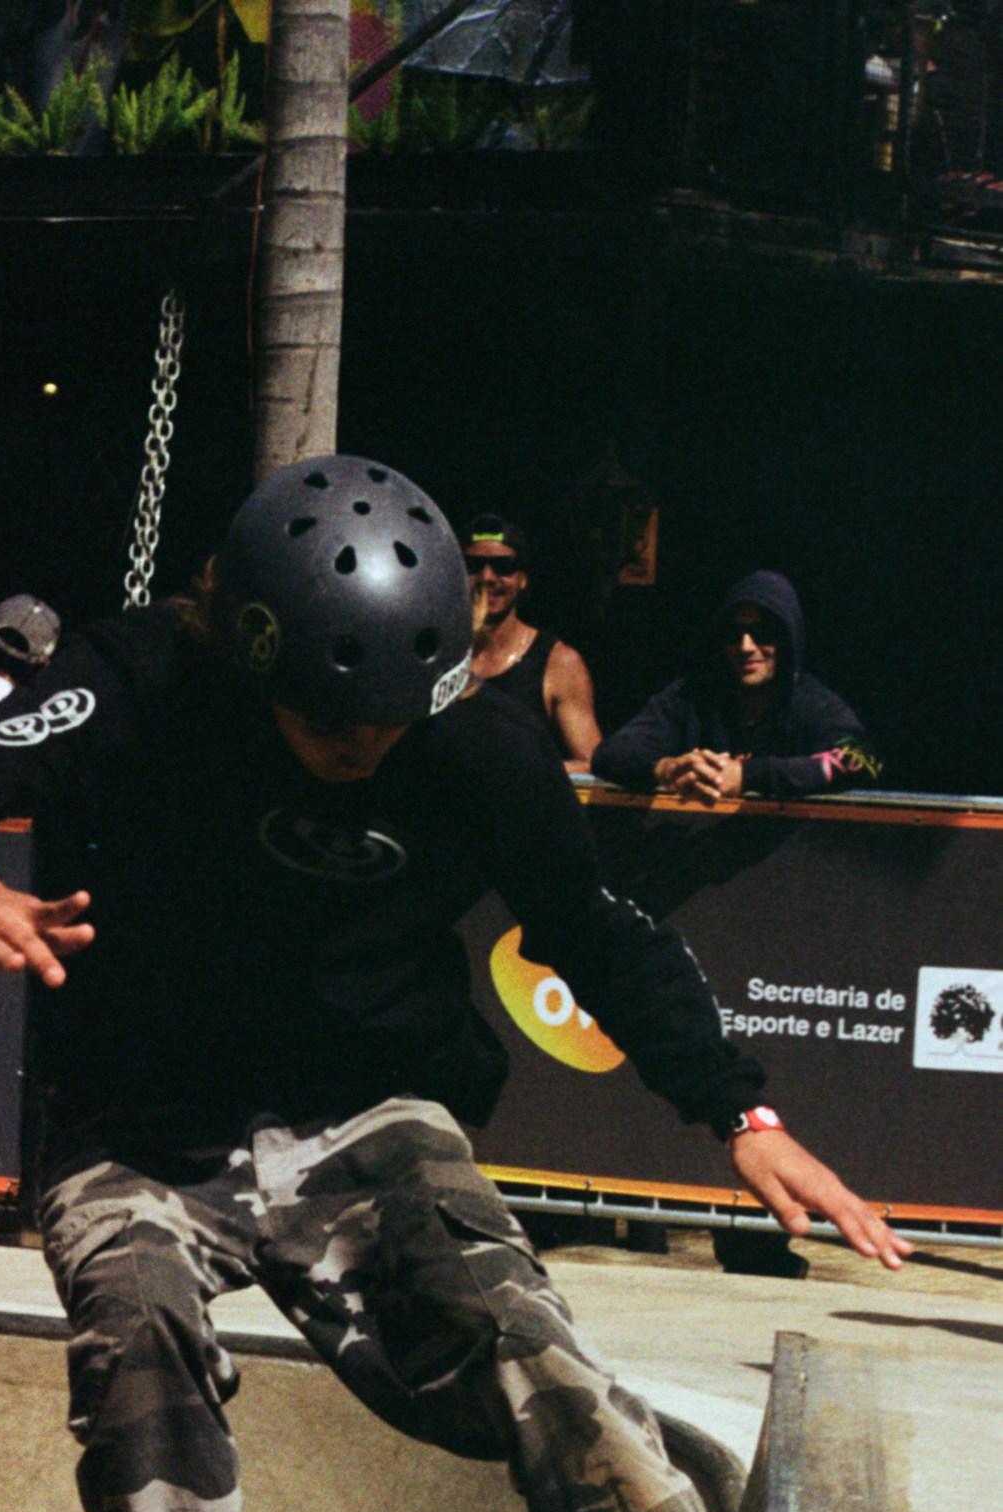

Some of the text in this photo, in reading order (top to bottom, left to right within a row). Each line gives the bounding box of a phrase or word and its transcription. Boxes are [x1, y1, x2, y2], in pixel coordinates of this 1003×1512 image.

[747, 977, 907, 1012] Secretaria de
[816, 1019, 831, 1037] e
[838, 1016, 905, 1044] Lazer
